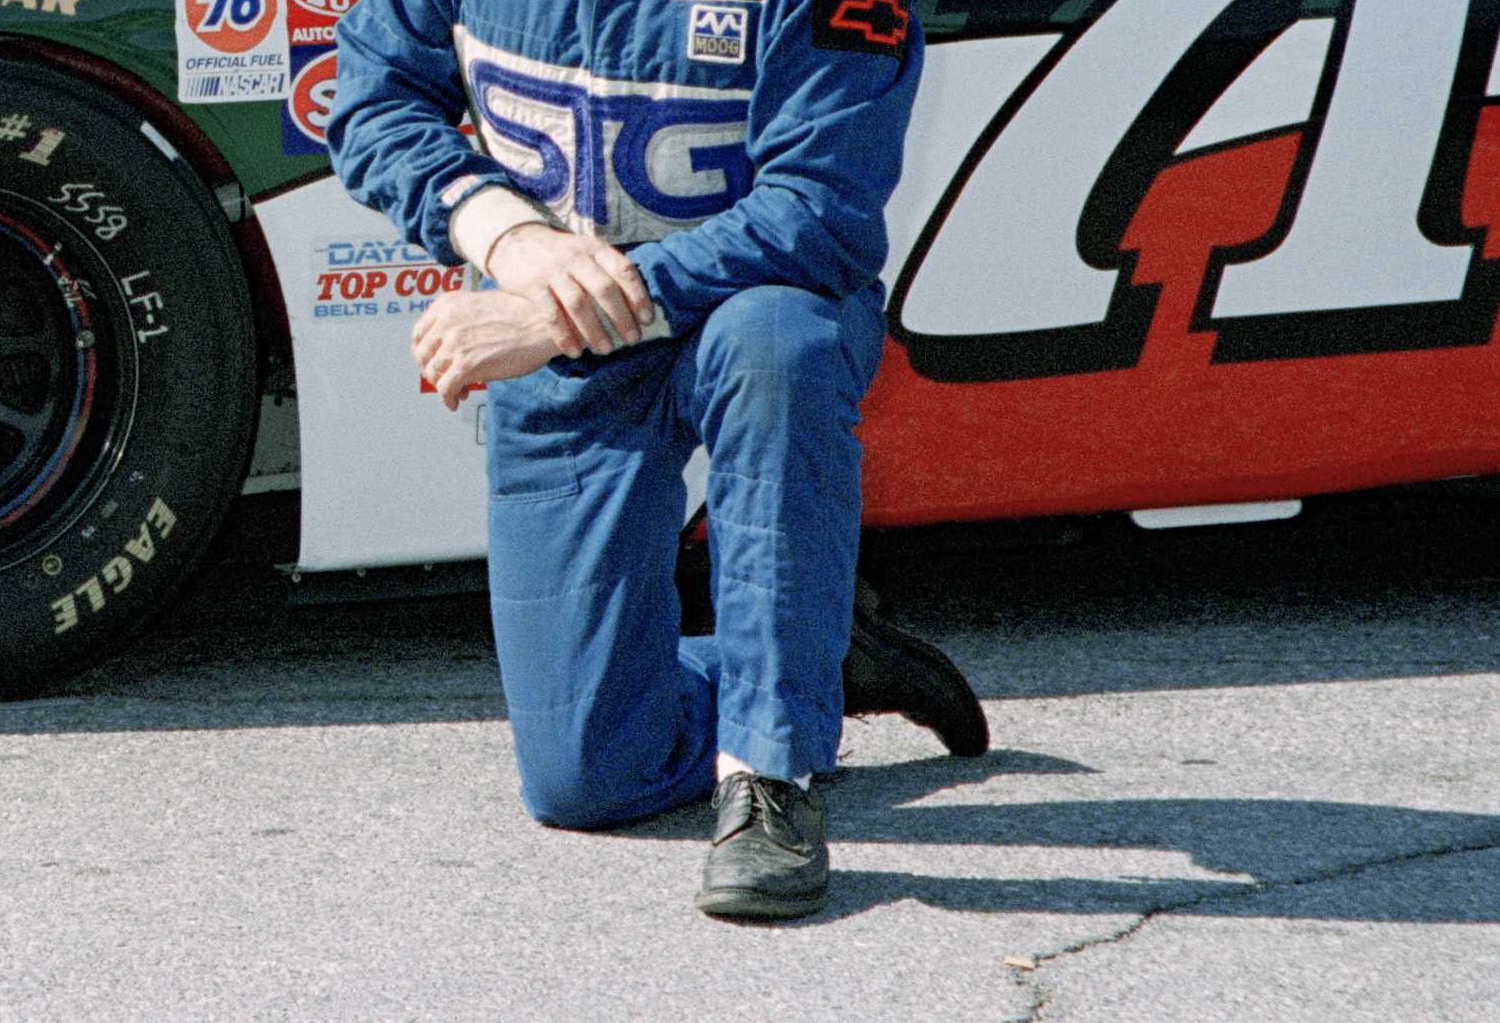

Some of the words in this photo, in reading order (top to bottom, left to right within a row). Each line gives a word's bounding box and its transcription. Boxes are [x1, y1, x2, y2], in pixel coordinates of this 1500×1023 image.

[694, 38, 741, 54] MOOG
[186, 57, 247, 70] OFFICIAL
[250, 54, 285, 67] FUEL
[316, 270, 388, 301] TOP
[394, 266, 465, 297] COG
[314, 302, 378, 318] BELTS
[386, 301, 402, 314] &
[51, 496, 178, 635] EAGLE
